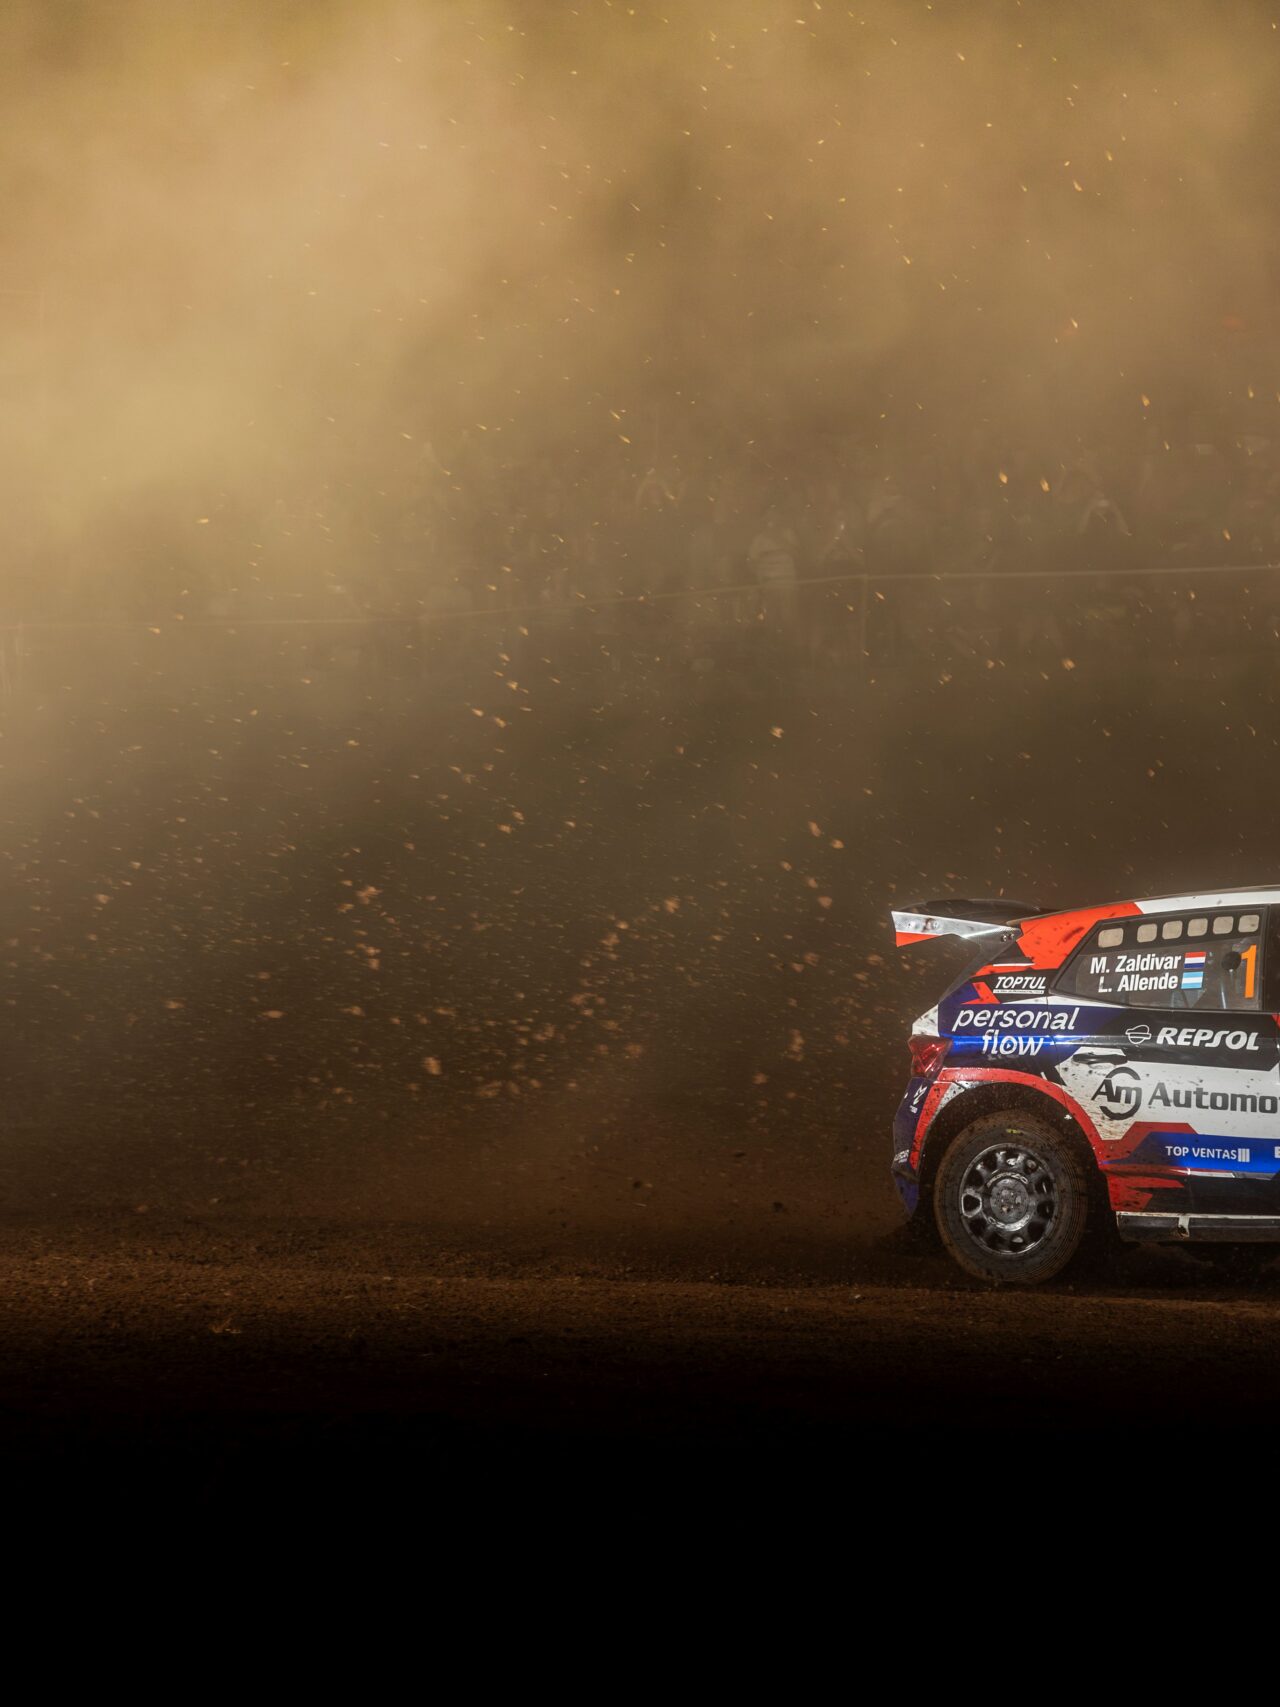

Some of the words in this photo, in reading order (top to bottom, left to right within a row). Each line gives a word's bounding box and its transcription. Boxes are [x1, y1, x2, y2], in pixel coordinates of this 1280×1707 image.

[1090, 956, 1110, 974] M.
[1115, 953, 1181, 973] Zaldivar
[1241, 945, 1257, 998] 1
[995, 976, 1047, 990] TOPTUL
[1098, 976, 1112, 993] L.
[1117, 972, 1178, 992] Allende
[952, 1007, 1080, 1032] personal
[982, 1029, 1044, 1056] flow
[1156, 1027, 1260, 1051] REPSOL
[1165, 1145, 1190, 1157] TOP
[1192, 1147, 1237, 1160] VENTAS
